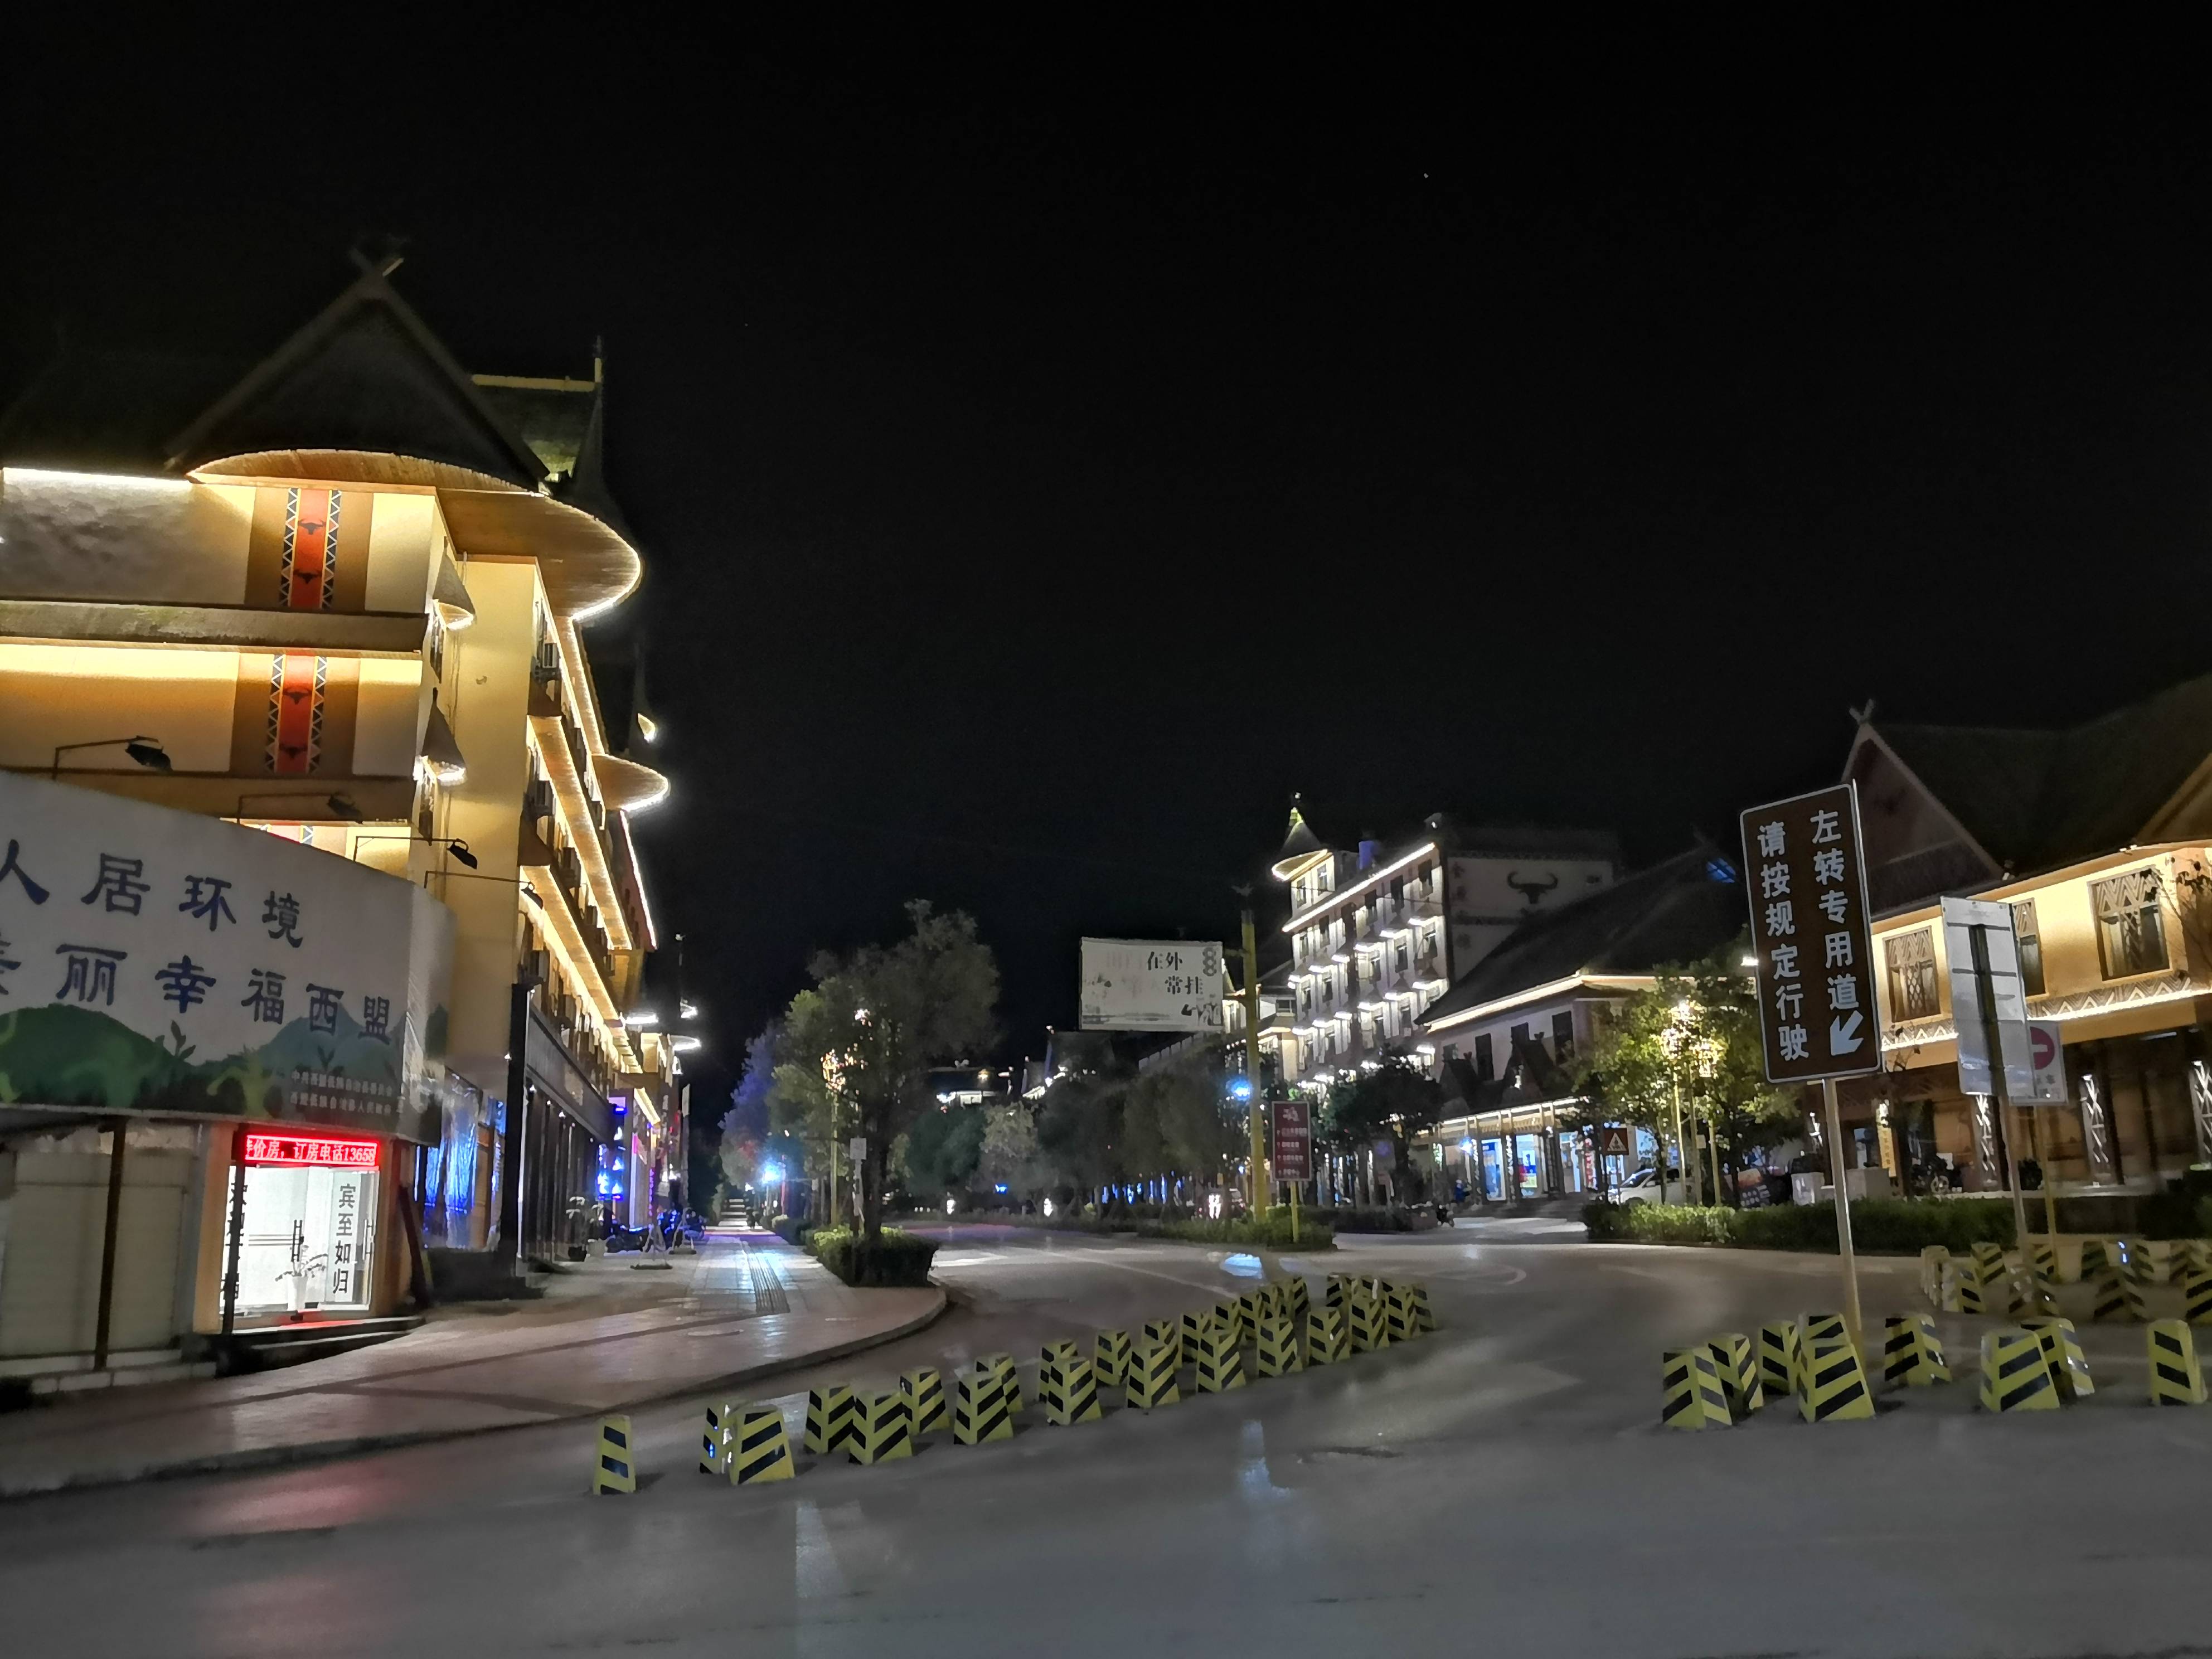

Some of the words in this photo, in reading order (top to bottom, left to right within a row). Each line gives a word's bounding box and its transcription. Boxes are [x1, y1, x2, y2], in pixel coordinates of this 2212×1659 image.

[0, 838, 304, 948] 人居环境
[1757, 821, 1810, 1061] 请按规定行驶
[1810, 809, 1859, 1010] 左转专用道
[333, 1183, 356, 1294] 宾至如归
